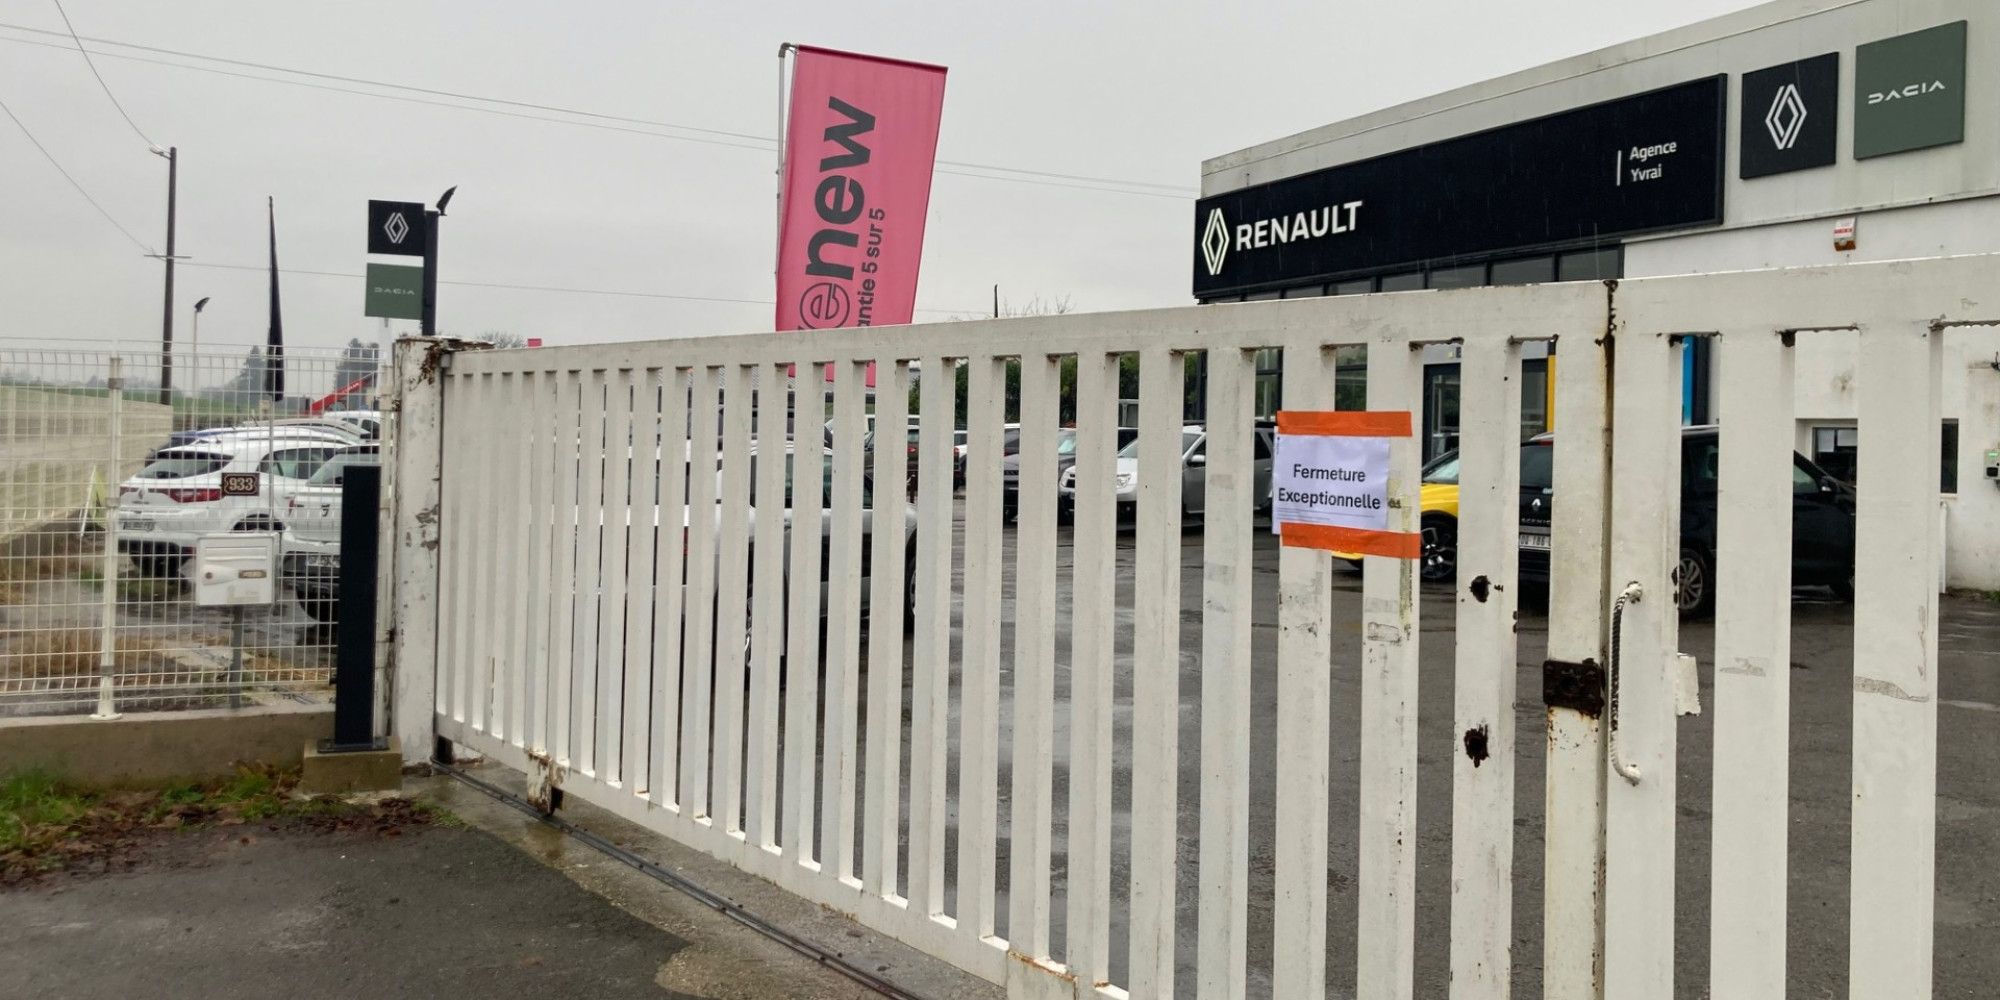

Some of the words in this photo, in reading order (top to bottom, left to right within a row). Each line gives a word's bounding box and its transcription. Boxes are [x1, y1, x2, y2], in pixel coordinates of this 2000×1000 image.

[1867, 80, 1945, 104] DACIA
[1629, 141, 1677, 162] Agence
[1630, 163, 1662, 182] Yvrai
[798, 96, 876, 330] enew
[869, 208, 885, 220] 5
[1236, 200, 1363, 251] RENAULT
[868, 224, 883, 258] sur
[863, 262, 877, 273] 5
[1293, 463, 1366, 483] Fermeture
[229, 477, 254, 491] 933
[1278, 487, 1381, 510] Exceptionnelle
